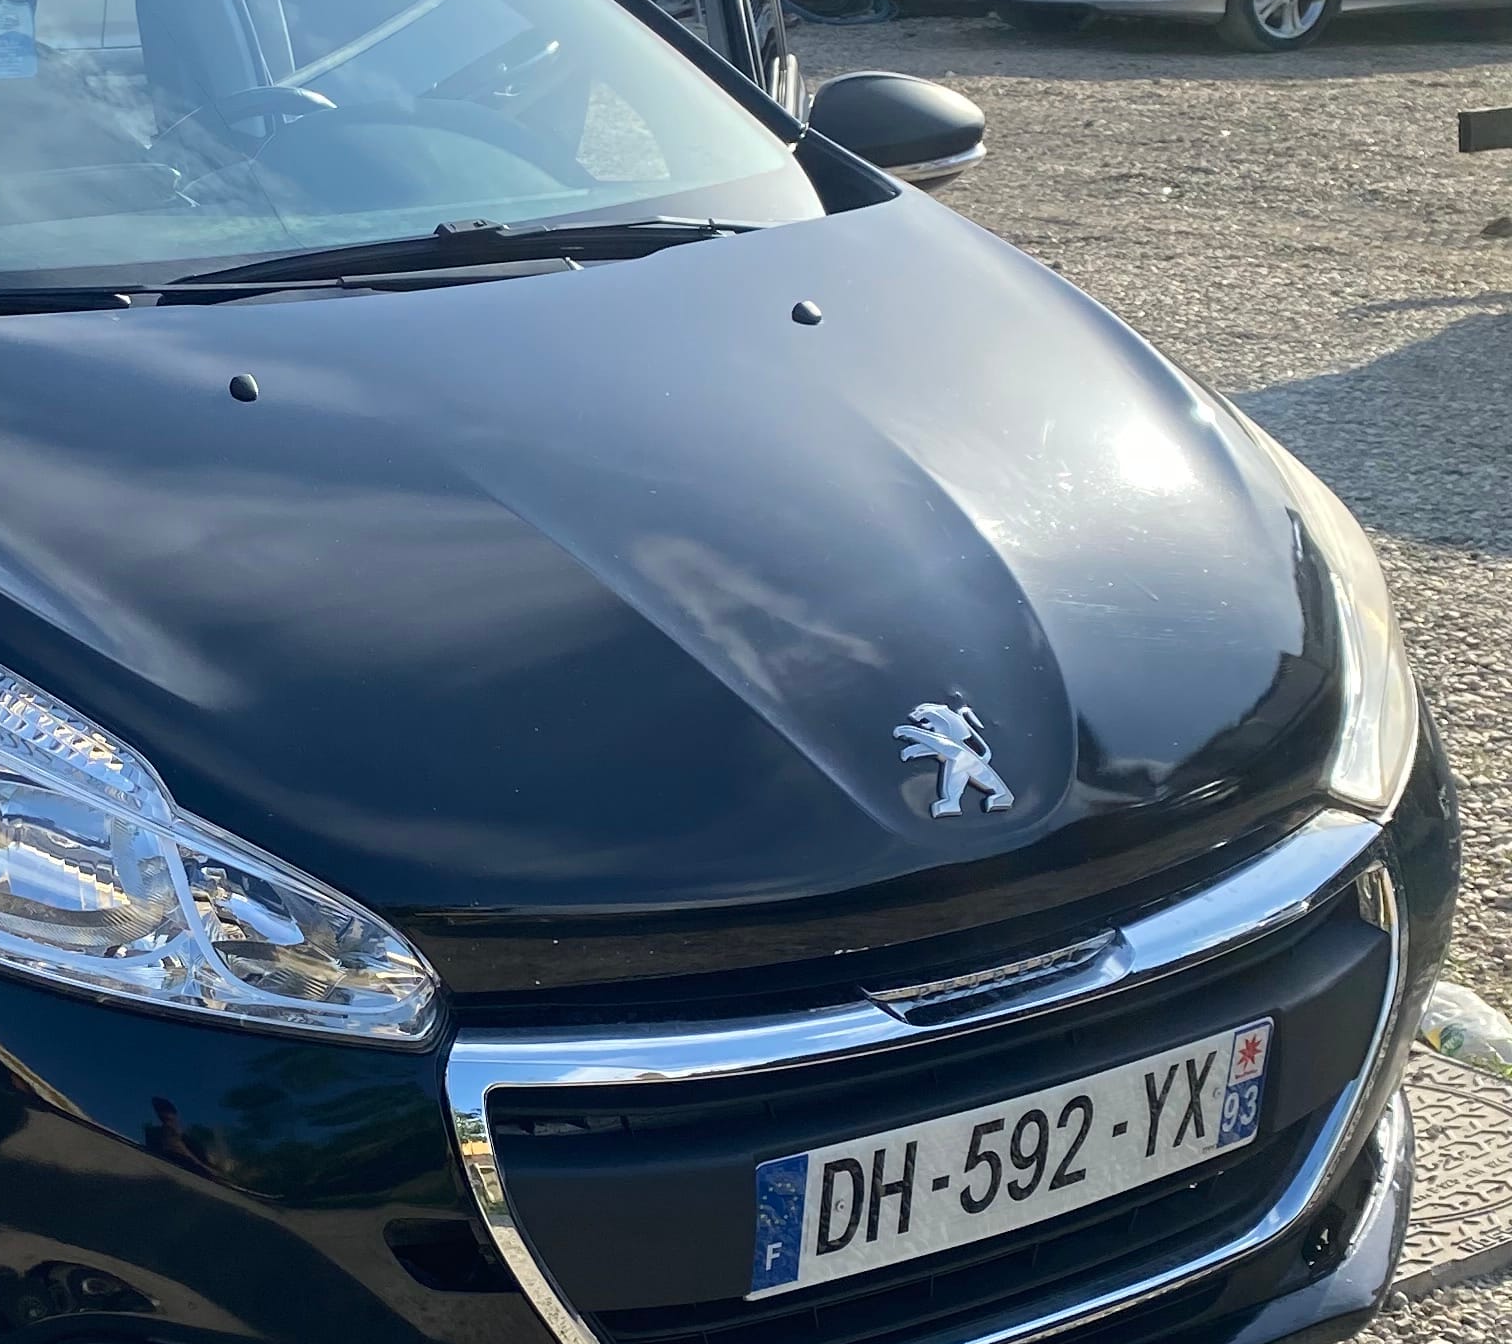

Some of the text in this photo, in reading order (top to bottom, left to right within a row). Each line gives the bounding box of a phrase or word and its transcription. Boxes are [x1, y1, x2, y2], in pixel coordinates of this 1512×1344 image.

[1222, 1084, 1259, 1133] 93
[815, 1050, 1218, 1257] DH-592-YX
[765, 1242, 782, 1272] F
